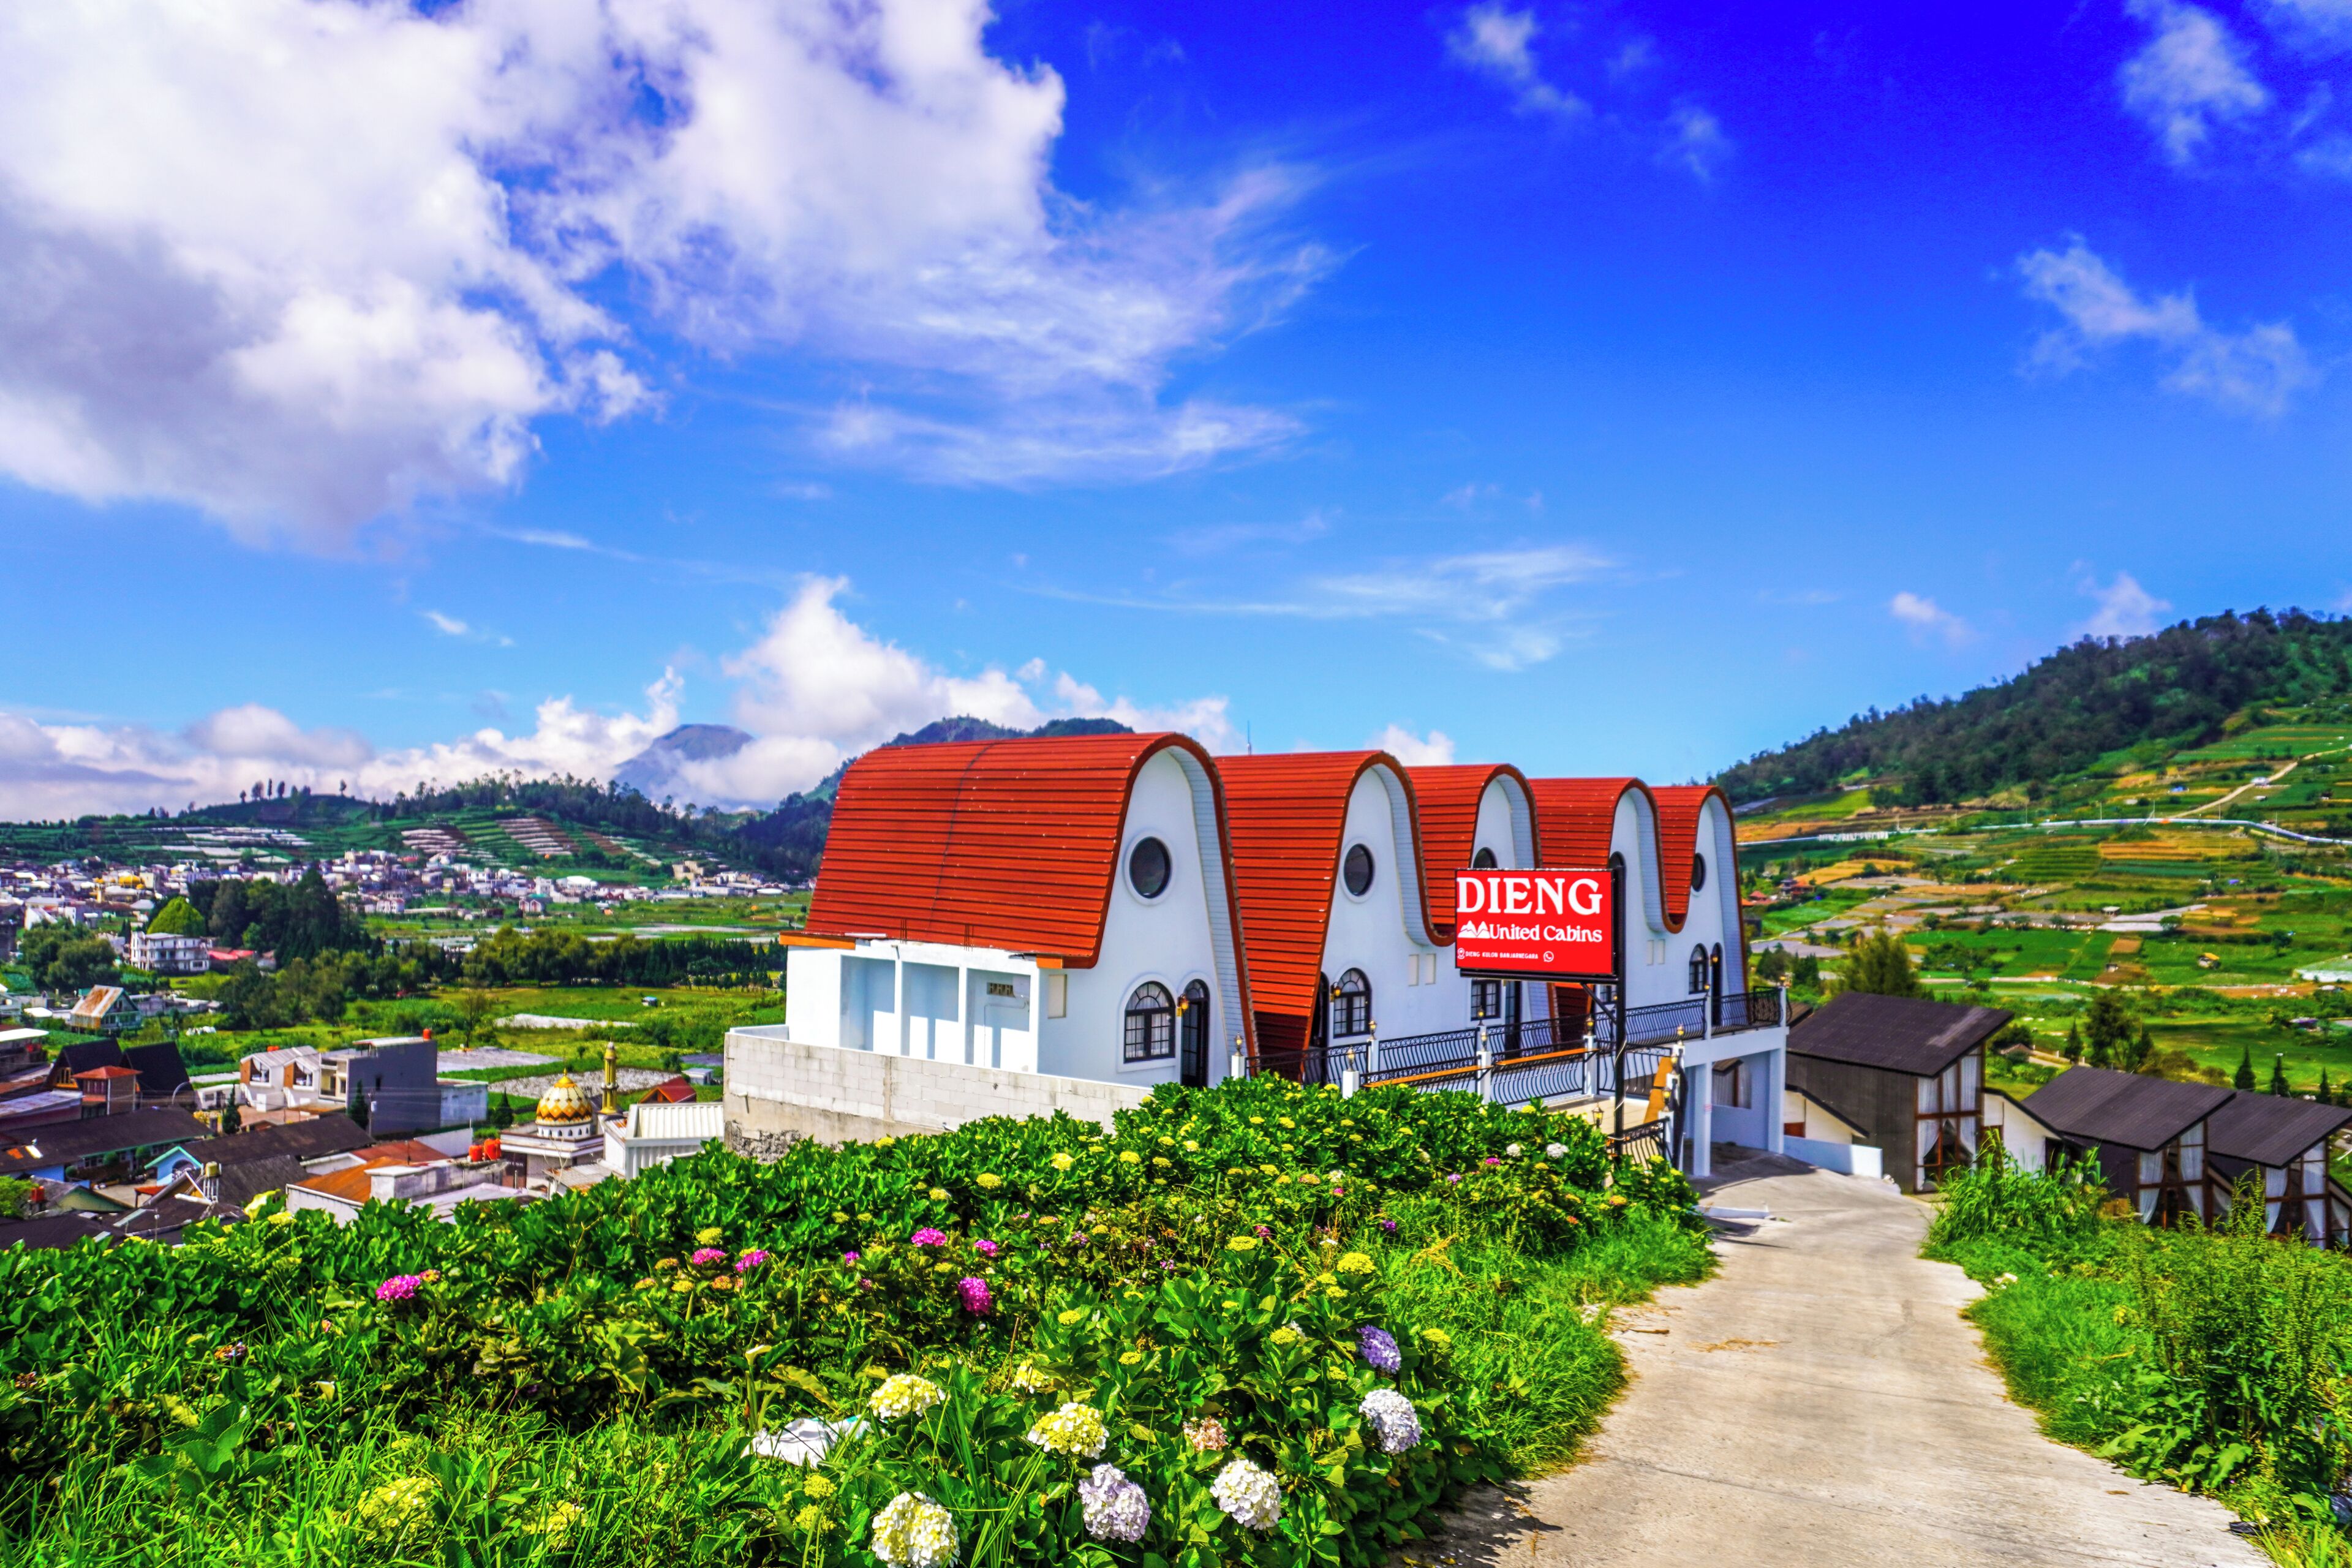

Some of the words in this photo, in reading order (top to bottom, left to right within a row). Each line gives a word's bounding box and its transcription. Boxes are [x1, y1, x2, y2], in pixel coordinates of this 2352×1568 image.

[1457, 877, 1603, 915] DIENG
[1489, 924, 1540, 941] United
[1544, 925, 1603, 943] Cabins
